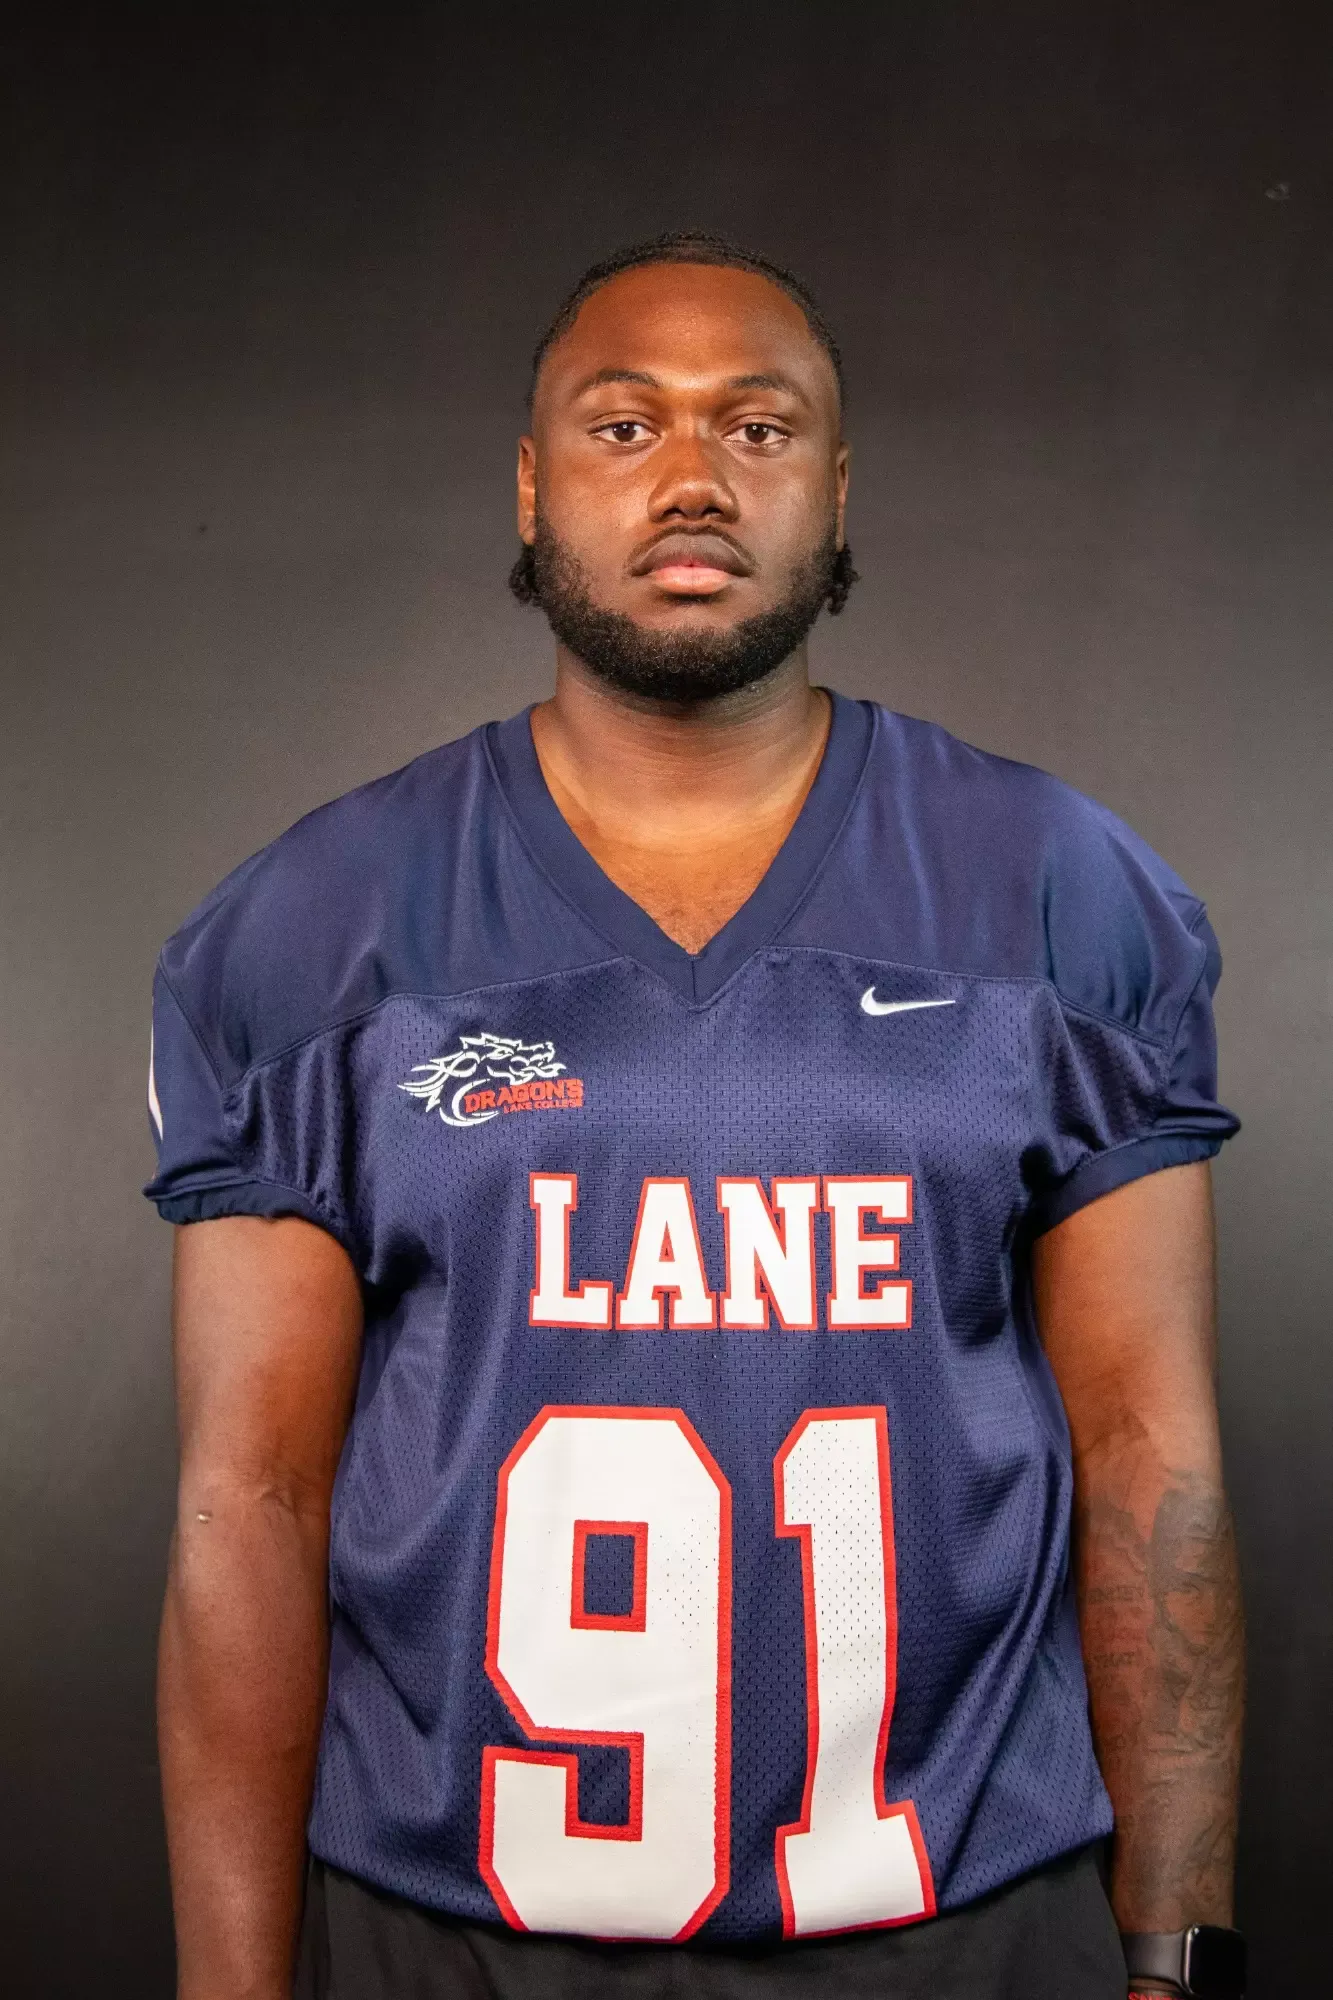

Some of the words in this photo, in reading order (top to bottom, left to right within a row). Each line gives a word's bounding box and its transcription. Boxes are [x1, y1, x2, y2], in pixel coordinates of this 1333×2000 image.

[463, 1078, 584, 1114] DRAGONS
[529, 1172, 913, 1331] LANE
[479, 1405, 937, 1942] 91
